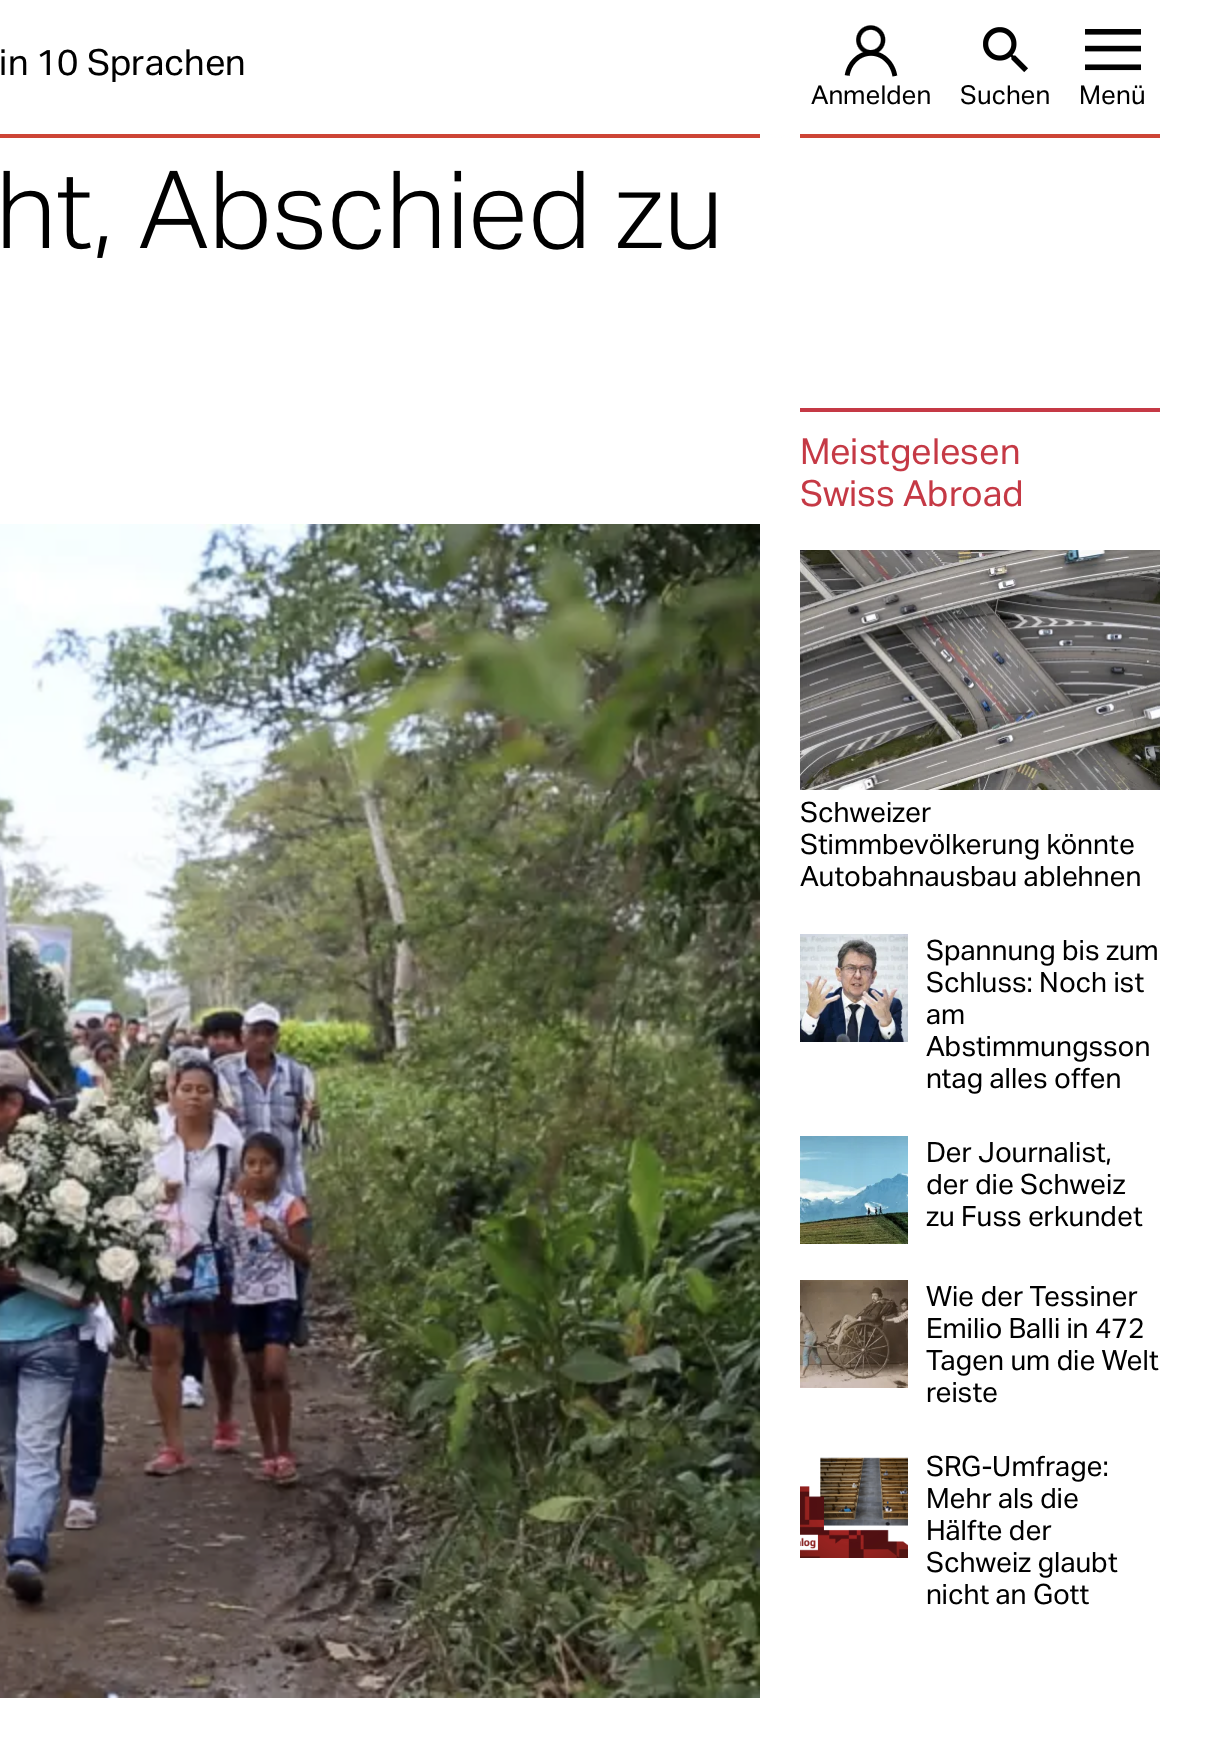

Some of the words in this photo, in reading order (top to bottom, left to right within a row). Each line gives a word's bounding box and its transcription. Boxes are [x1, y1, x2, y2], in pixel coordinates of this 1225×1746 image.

[1, 48, 27, 76] in
[40, 48, 77, 76] 10
[88, 48, 244, 82] Sprachen
[811, 85, 930, 105] Anmelden
[961, 85, 1049, 105] Suchen
[1081, 85, 1144, 105] Menü
[140, 171, 584, 250] Abschied
[618, 192, 718, 250] zu
[802, 438, 1019, 472] Meistgelesen
[801, 479, 893, 507] Swiss
[903, 479, 1022, 507] Abroad
[801, 801, 931, 823] Schweizer
[801, 833, 1039, 860] Stimmbevölkerung
[1048, 833, 1134, 855] könnte
[800, 866, 1016, 887] Autobahnausbau
[1024, 866, 1140, 887] ablehnen
[927, 939, 1054, 966] Spannung
[1064, 940, 1099, 961] bis
[1107, 945, 1157, 961] zum
[927, 971, 1031, 993] Schluss:
[1041, 972, 1105, 993] Noch
[1115, 972, 1144, 993] ist
[927, 1009, 964, 1025] am
[926, 1036, 1149, 1062] Abstimmungsson
[928, 1069, 982, 1094] ntag
[990, 1068, 1047, 1090] alles
[1055, 1068, 1120, 1090] offen
[928, 1142, 971, 1163] Der
[979, 1142, 1110, 1165] Journalist,
[927, 1174, 968, 1195] der
[976, 1174, 1013, 1195] die
[1021, 1173, 1125, 1195] Schweiz
[927, 1211, 954, 1227] zu
[963, 1206, 1021, 1227] Fuss
[1029, 1206, 1143, 1227] erkundet
[926, 1286, 973, 1307] Wie
[982, 1286, 1023, 1307] der
[1030, 1286, 1137, 1307] Tessiner
[928, 1318, 1001, 1339] Emilio
[1010, 1318, 1059, 1339] Balli
[1068, 1318, 1087, 1339] in
[1096, 1318, 1143, 1339] 472
[926, 1350, 1002, 1376] Tagen
[1012, 1355, 1049, 1371] um
[1058, 1350, 1094, 1371] die
[1102, 1350, 1159, 1371] Welt
[928, 1382, 997, 1403] reiste
[927, 1455, 1107, 1482] SRG-Umfrage:
[928, 1488, 991, 1509] Mehr
[999, 1488, 1033, 1509] als
[1041, 1488, 1078, 1509] die
[928, 1520, 1001, 1541] Hälfte
[1010, 1520, 1051, 1541] der
[800, 1538, 816, 1549] log
[927, 1551, 1031, 1573] Schweiz
[1039, 1552, 1118, 1578] glaubt
[928, 1584, 989, 1605] nicht
[996, 1589, 1025, 1605] an
[1034, 1583, 1089, 1605] Gott
